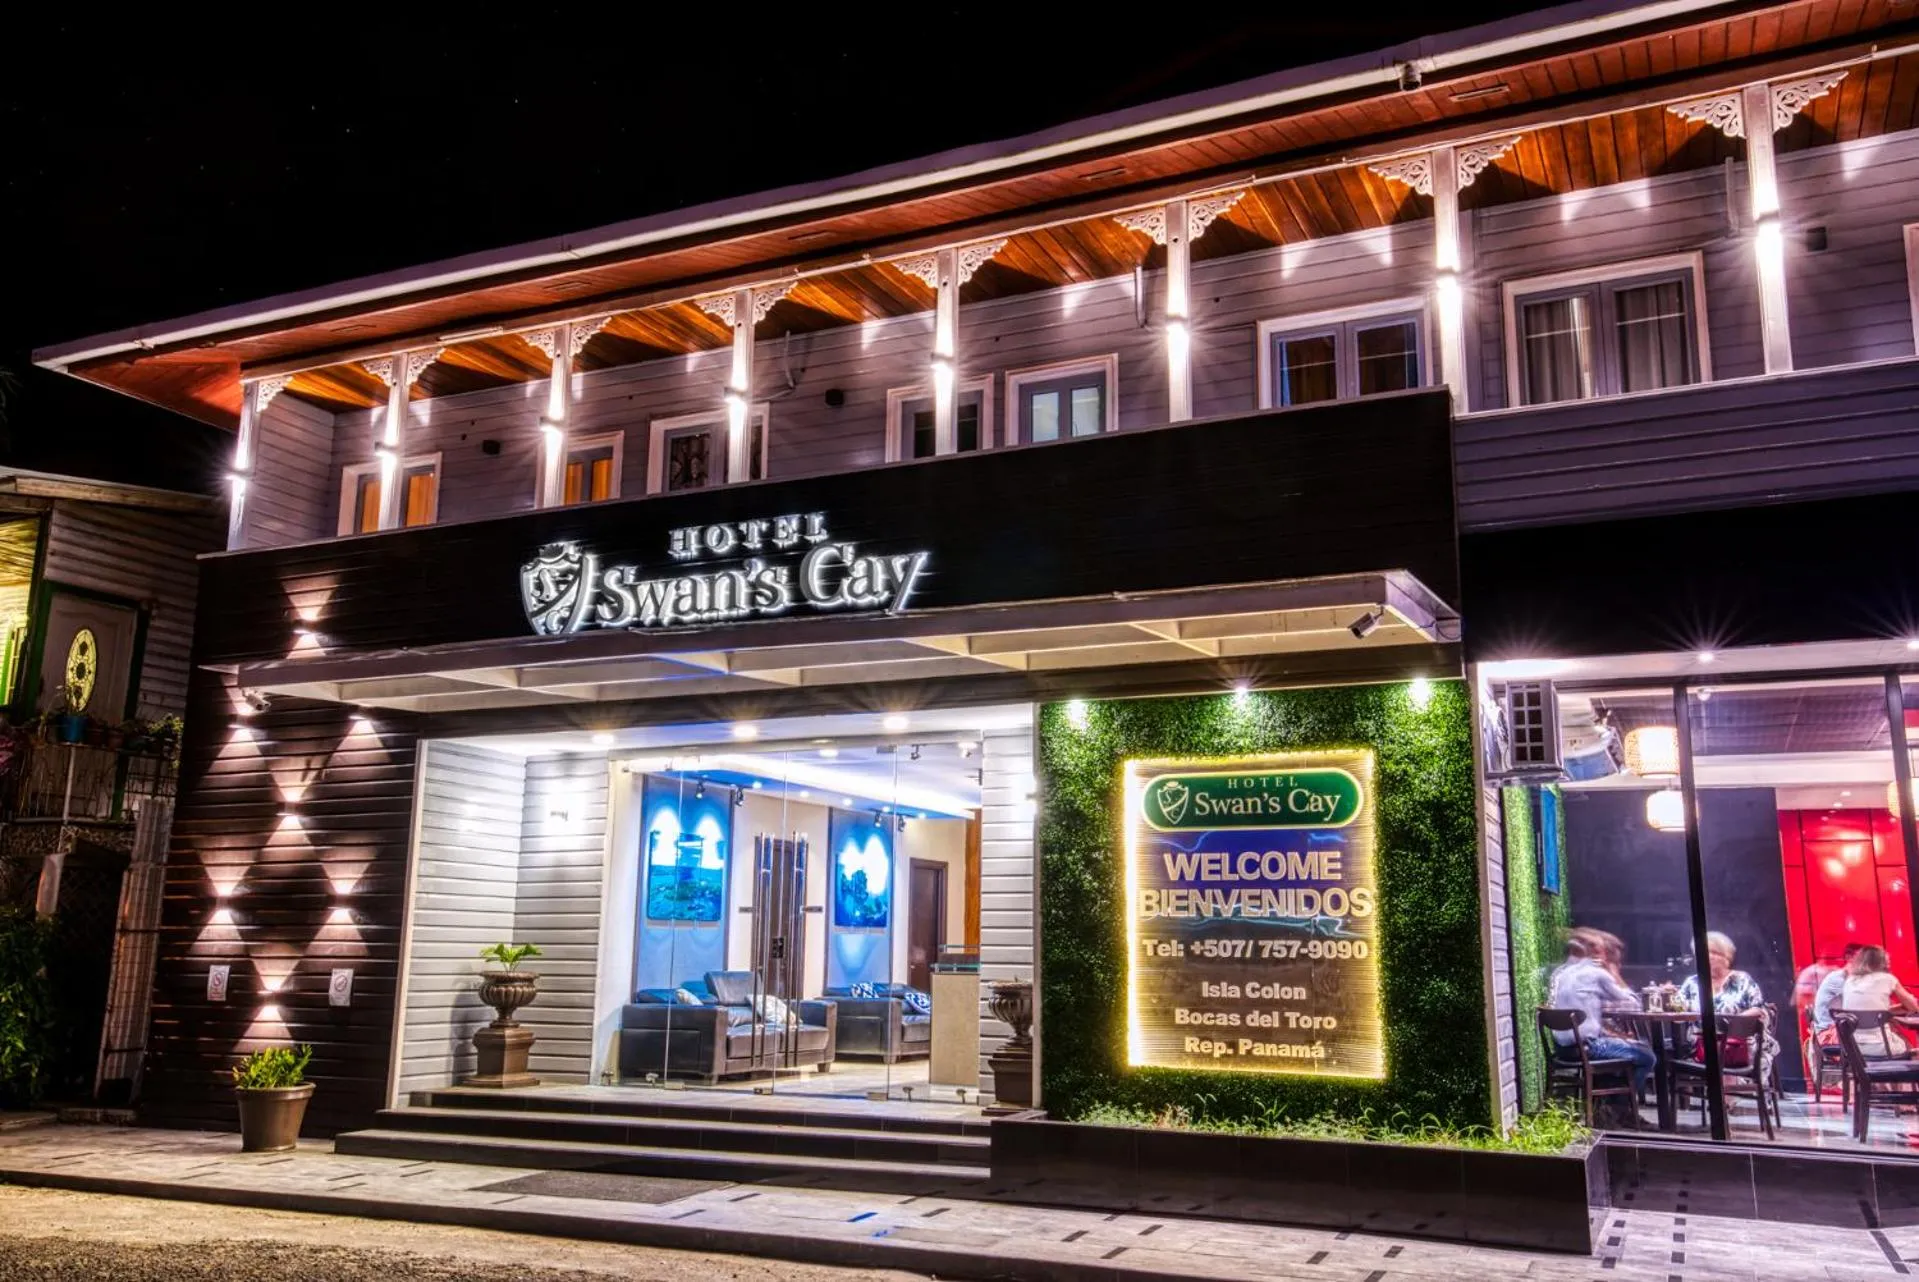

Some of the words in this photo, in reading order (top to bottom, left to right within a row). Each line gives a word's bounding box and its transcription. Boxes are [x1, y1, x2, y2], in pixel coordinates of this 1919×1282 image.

[668, 511, 830, 558] HOTEL
[600, 557, 792, 627] Swan's
[801, 543, 929, 616] Cay
[1228, 776, 1298, 789] HOTEL
[1195, 792, 1281, 816] Swan's
[1288, 788, 1341, 822] Cay
[1164, 851, 1342, 882] WELCOME
[1139, 887, 1374, 918] BIENVENIDOS
[1142, 939, 1184, 957] Tel:
[1190, 940, 1253, 958] +507/
[1258, 940, 1368, 959] 757-9090
[1202, 981, 1241, 998] Isla
[1245, 982, 1307, 1000] Colon
[1174, 1008, 1241, 1026] Bocas
[1245, 1010, 1280, 1028] del
[1284, 1011, 1337, 1030] Toro
[1184, 1036, 1234, 1058] Rep.
[1238, 1038, 1326, 1058] Panamá
